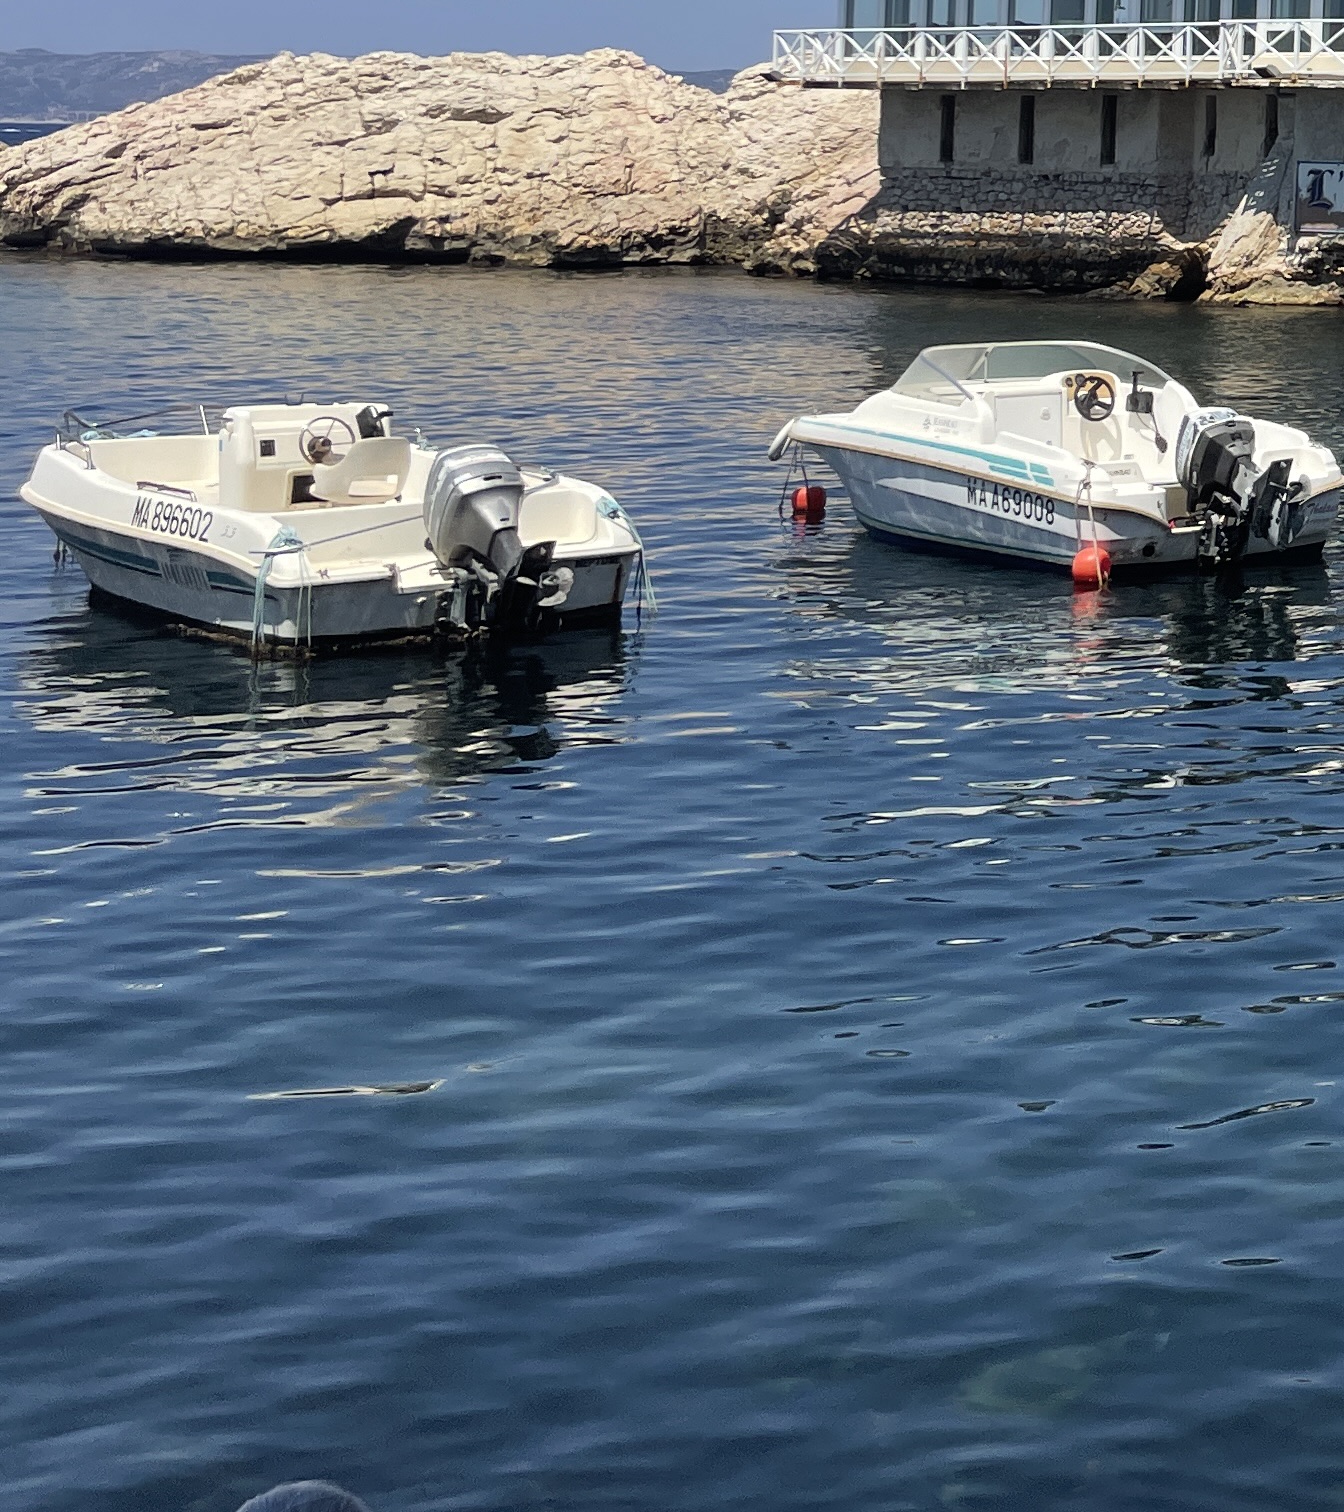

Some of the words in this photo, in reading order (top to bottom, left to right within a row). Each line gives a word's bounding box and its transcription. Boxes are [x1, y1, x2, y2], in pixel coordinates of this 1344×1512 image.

[131, 496, 153, 529] MA
[152, 500, 213, 542] 896602
[967, 477, 988, 506] MA
[991, 482, 1056, 525] A69008
